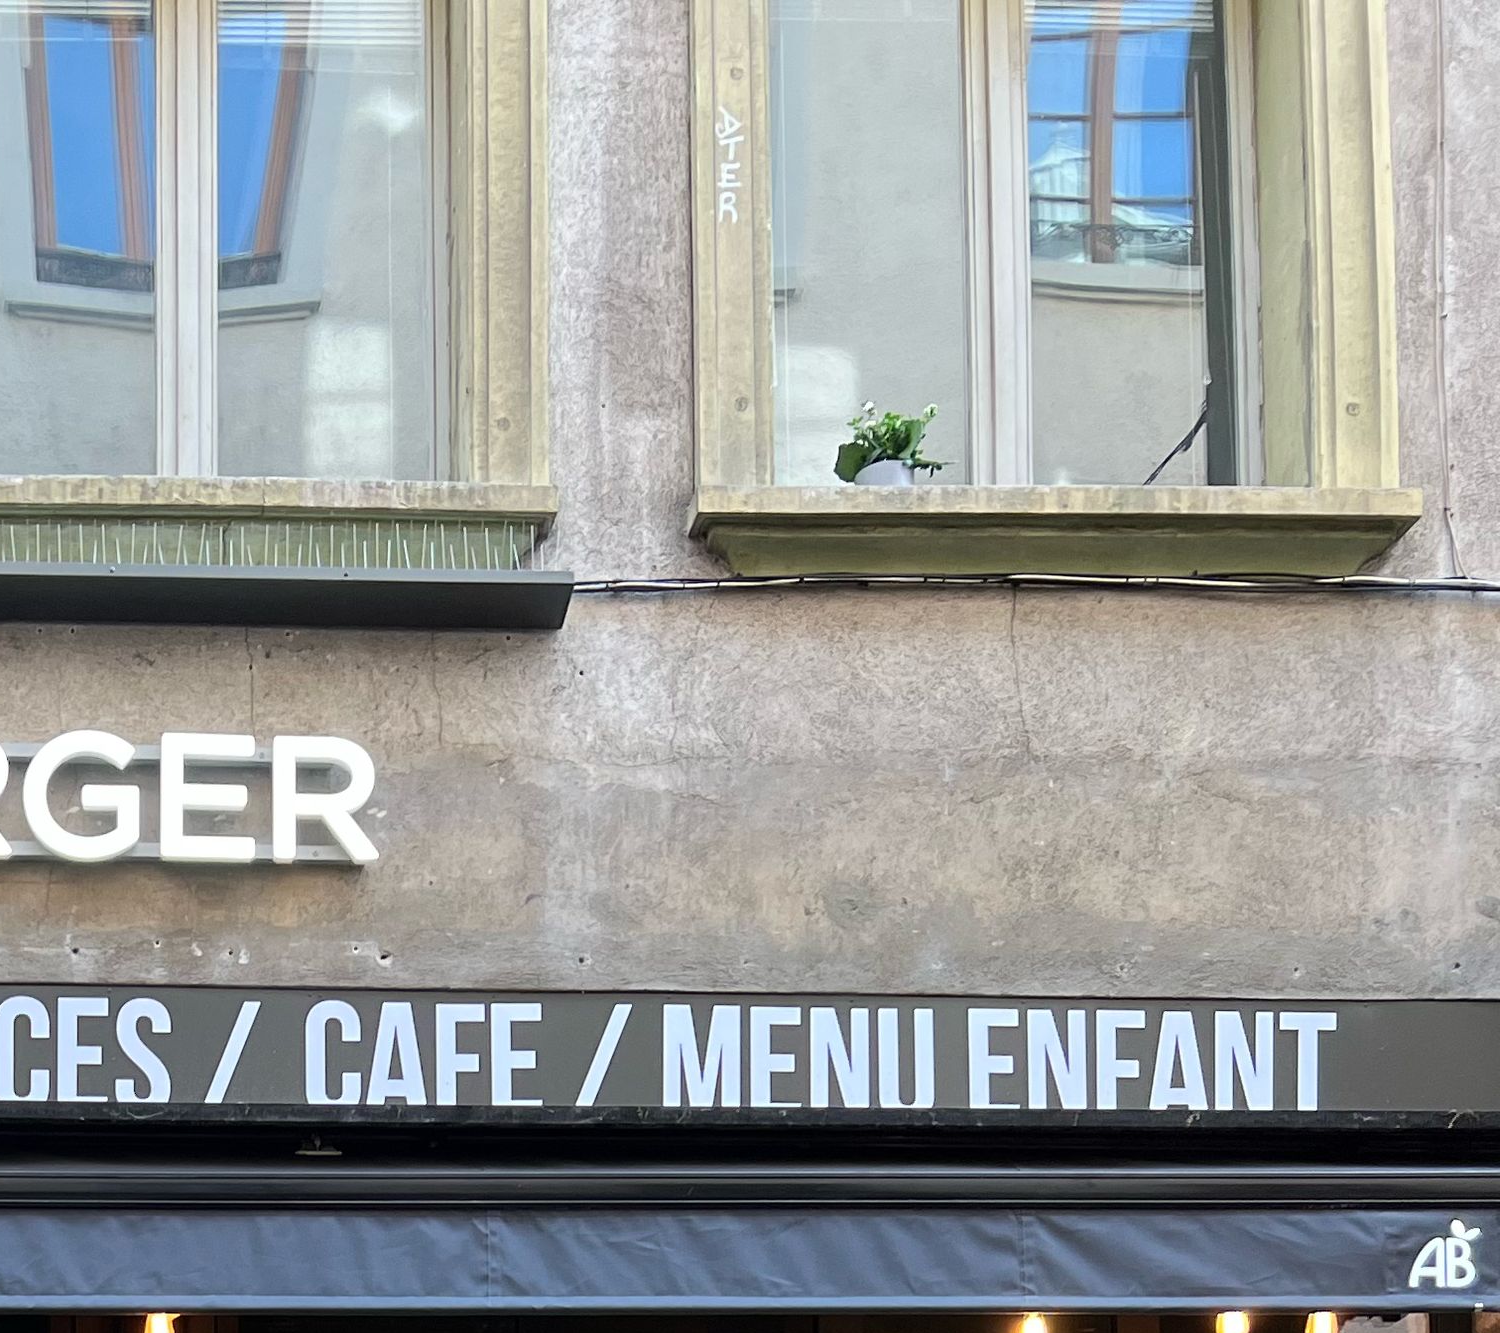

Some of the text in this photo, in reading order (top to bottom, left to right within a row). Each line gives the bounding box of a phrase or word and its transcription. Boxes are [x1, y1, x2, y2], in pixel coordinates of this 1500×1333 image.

[662, 1003, 935, 1109] MENU
[967, 1007, 1337, 1111] ENFANT
[1408, 1232, 1478, 1288] AB
